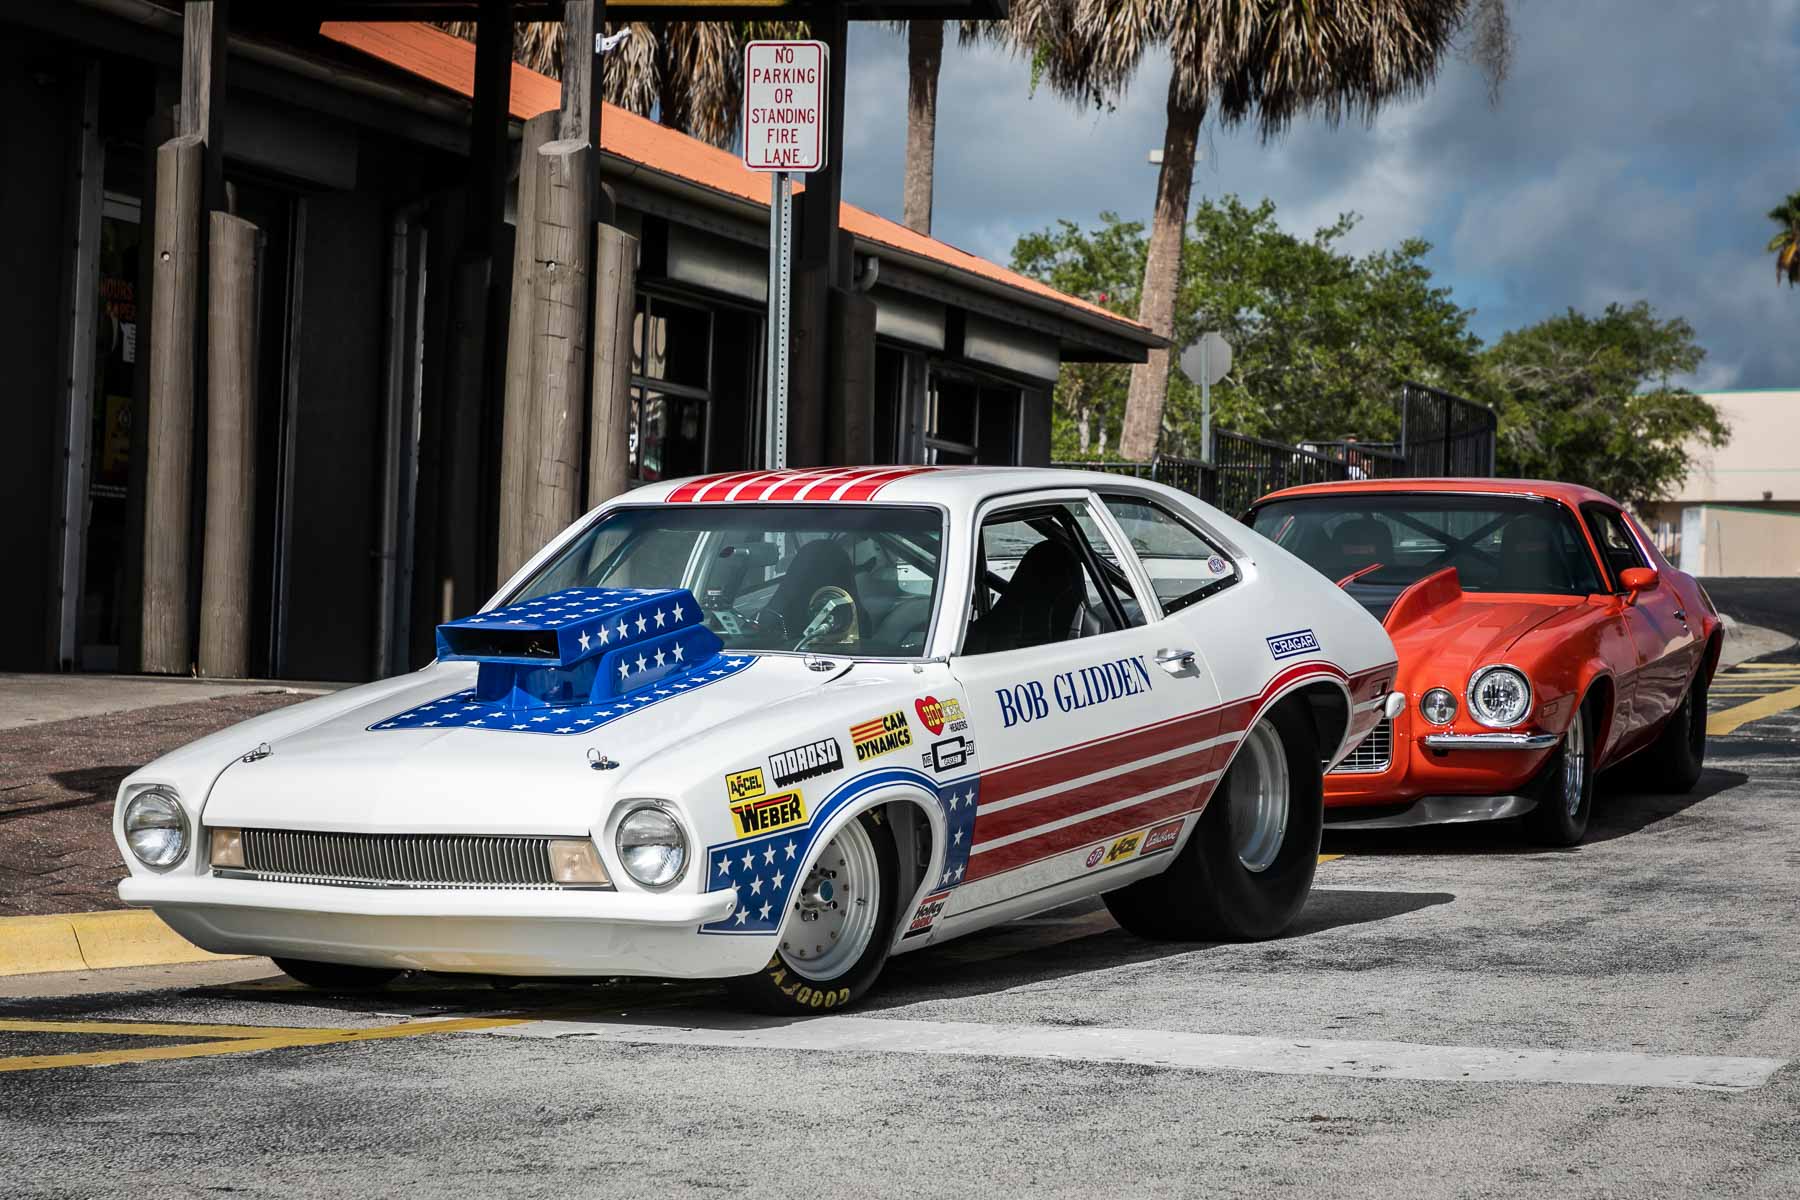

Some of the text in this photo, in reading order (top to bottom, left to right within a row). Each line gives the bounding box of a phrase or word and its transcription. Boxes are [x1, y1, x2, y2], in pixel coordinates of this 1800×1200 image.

[775, 48, 794, 64] NO
[752, 68, 816, 84] PARKING
[774, 88, 793, 104] OR
[751, 108, 816, 125] STANDING
[767, 128, 799, 144] FIRE
[764, 148, 801, 165] LANE
[1272, 635, 1315, 655] CRAGAR
[995, 655, 1153, 729] BOB GLIDDEN
[882, 712, 908, 732] CAM
[855, 728, 911, 761] DYNAMICS
[769, 738, 840, 783] MOROSO
[731, 775, 762, 797] ACCEL
[731, 793, 802, 833] WEBER
[913, 901, 945, 920] Holley
